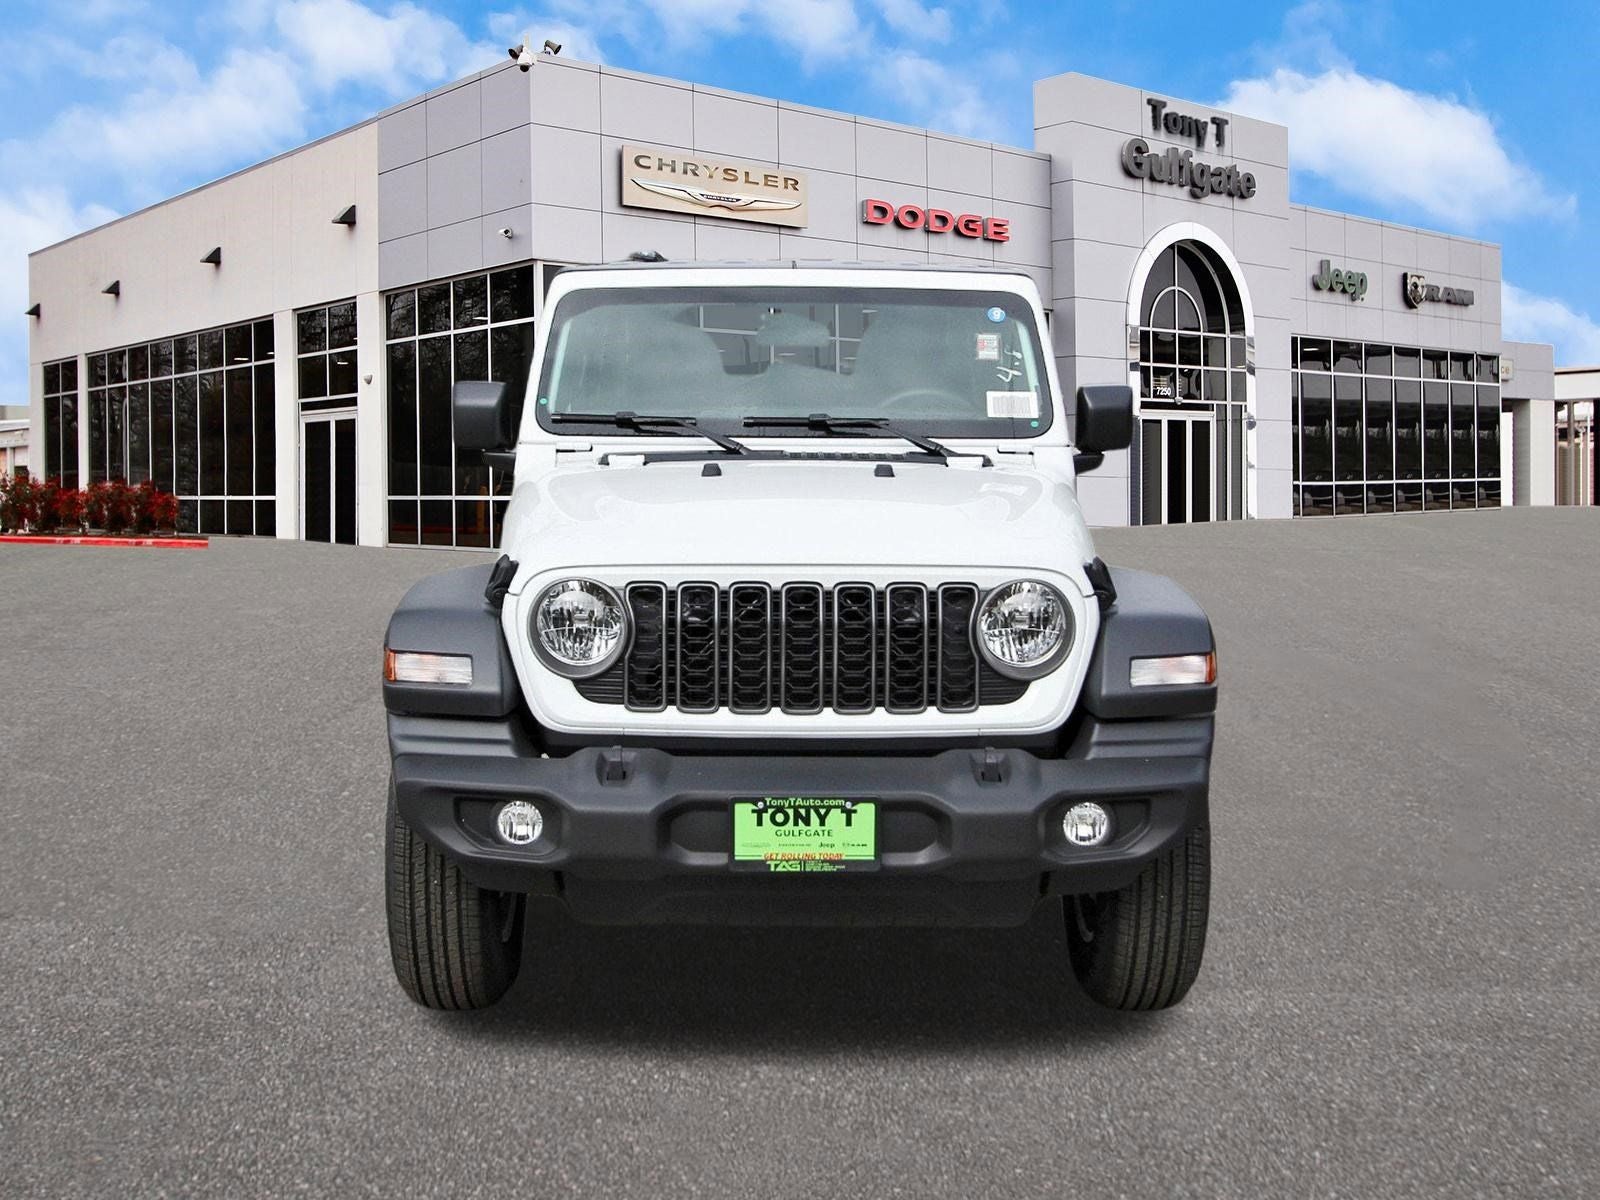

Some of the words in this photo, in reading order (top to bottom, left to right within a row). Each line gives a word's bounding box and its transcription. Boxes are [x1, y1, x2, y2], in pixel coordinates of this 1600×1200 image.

[1147, 98, 1208, 148] Tony
[1210, 116, 1229, 148] T
[634, 154, 800, 191] CHRYSLER
[1121, 138, 1256, 199] Gulfgate
[862, 199, 1010, 242] DODGE
[1312, 259, 1368, 301] Jeep
[1424, 284, 1475, 307] RAM
[1156, 387, 1171, 396] 7250
[764, 798, 845, 807] TonyTAuto.com
[751, 807, 832, 827] TONY
[840, 808, 857, 827] T
[775, 829, 833, 837] GULFGATE
[764, 852, 779, 860] GET
[780, 852, 816, 860] ROLLING
[819, 852, 844, 860] TODAY
[766, 860, 800, 871] TAG
